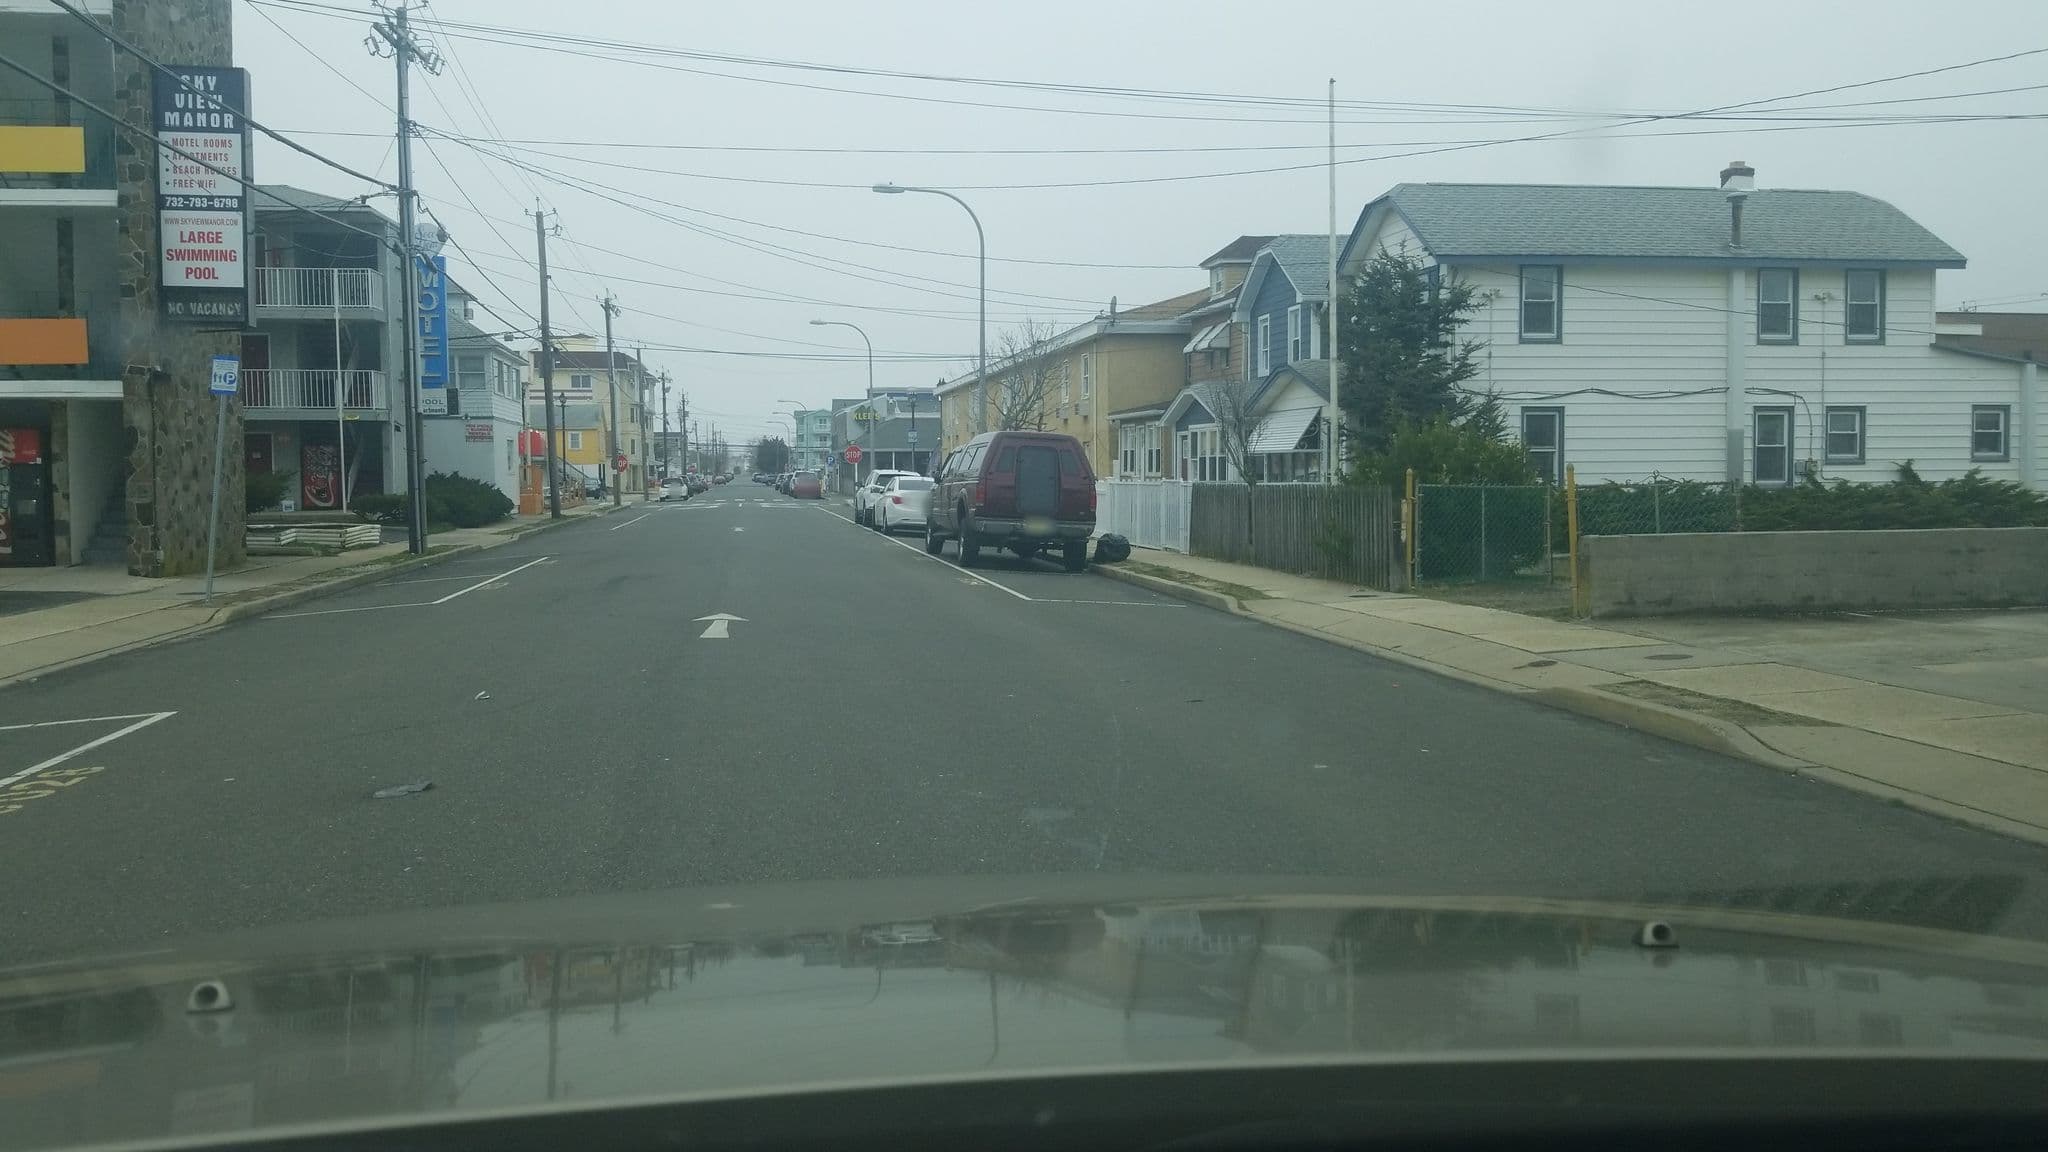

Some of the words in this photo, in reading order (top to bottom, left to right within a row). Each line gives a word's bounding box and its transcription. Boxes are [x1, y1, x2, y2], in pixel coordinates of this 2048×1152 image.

[180, 75, 217, 91] SKY
[174, 93, 223, 110] VIEW
[164, 111, 234, 129] MANOR
[171, 138, 200, 148] MOTEL
[203, 139, 233, 149] ROOMS
[172, 152, 229, 162] APARTMENTS
[172, 165, 201, 175] BEACH
[173, 179, 195, 188] FREE
[165, 197, 238, 208] 732-793-6798
[180, 230, 223, 244] LARGE
[166, 248, 238, 262] SWIMMING
[185, 267, 219, 280] POOL
[167, 302, 185, 315] NO
[190, 302, 241, 315] VACANCY
[418, 268, 442, 378] MOTEL
[846, 451, 861, 459] STOP
